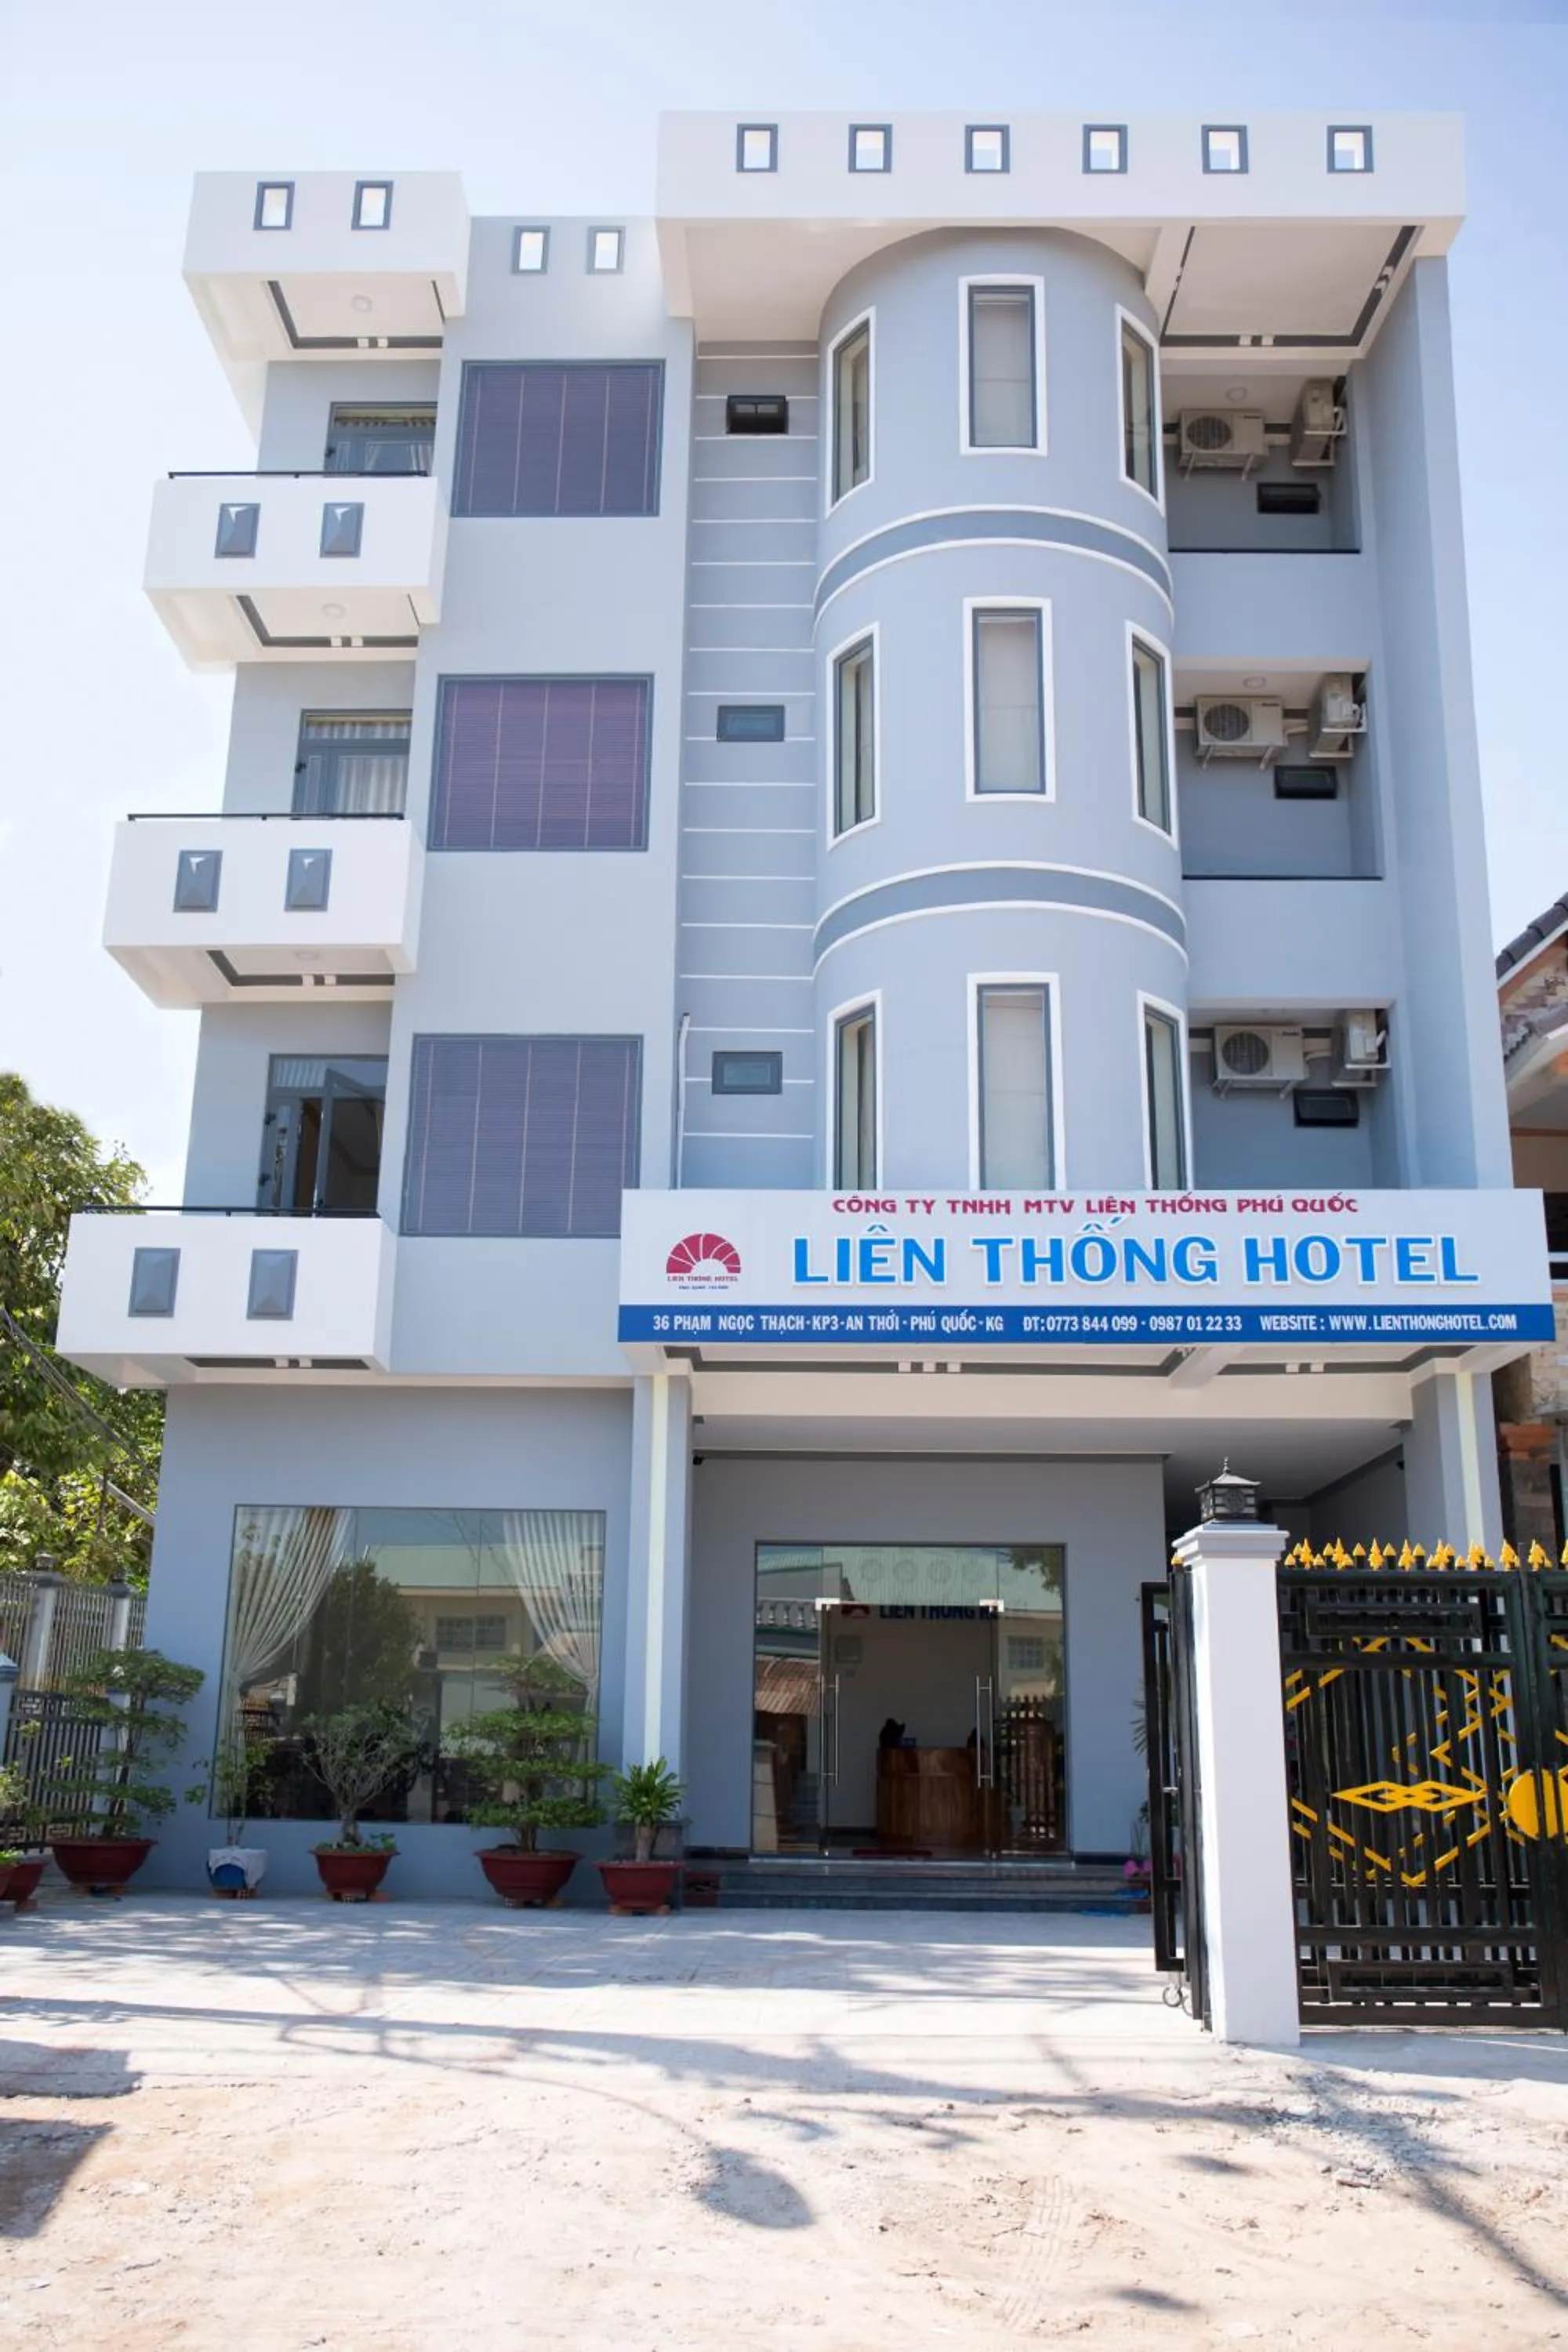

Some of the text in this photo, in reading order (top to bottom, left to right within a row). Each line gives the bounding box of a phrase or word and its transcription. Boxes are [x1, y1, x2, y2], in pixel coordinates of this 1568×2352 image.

[833, 1195, 897, 1213] CÔNG
[906, 1199, 936, 1214] TY
[946, 1199, 1011, 1214] TNHH
[1024, 1199, 1075, 1214] MTV
[1086, 1196, 1136, 1214] LIÊN
[1236, 1194, 1283, 1213] PHÚ
[1291, 1191, 1358, 1214] QUỐC
[793, 1216, 1479, 1283] LIÊN THỐNG HOTEL
[652, 1315, 670, 1330] 36
[673, 1315, 712, 1335] PHẠM
[718, 1315, 754, 1335] NGỌC
[1081, 1316, 1109, 1331] 844
[1111, 1316, 1138, 1331] 099
[1150, 1316, 1183, 1331] 0987
[1225, 1316, 1243, 1331] 33
